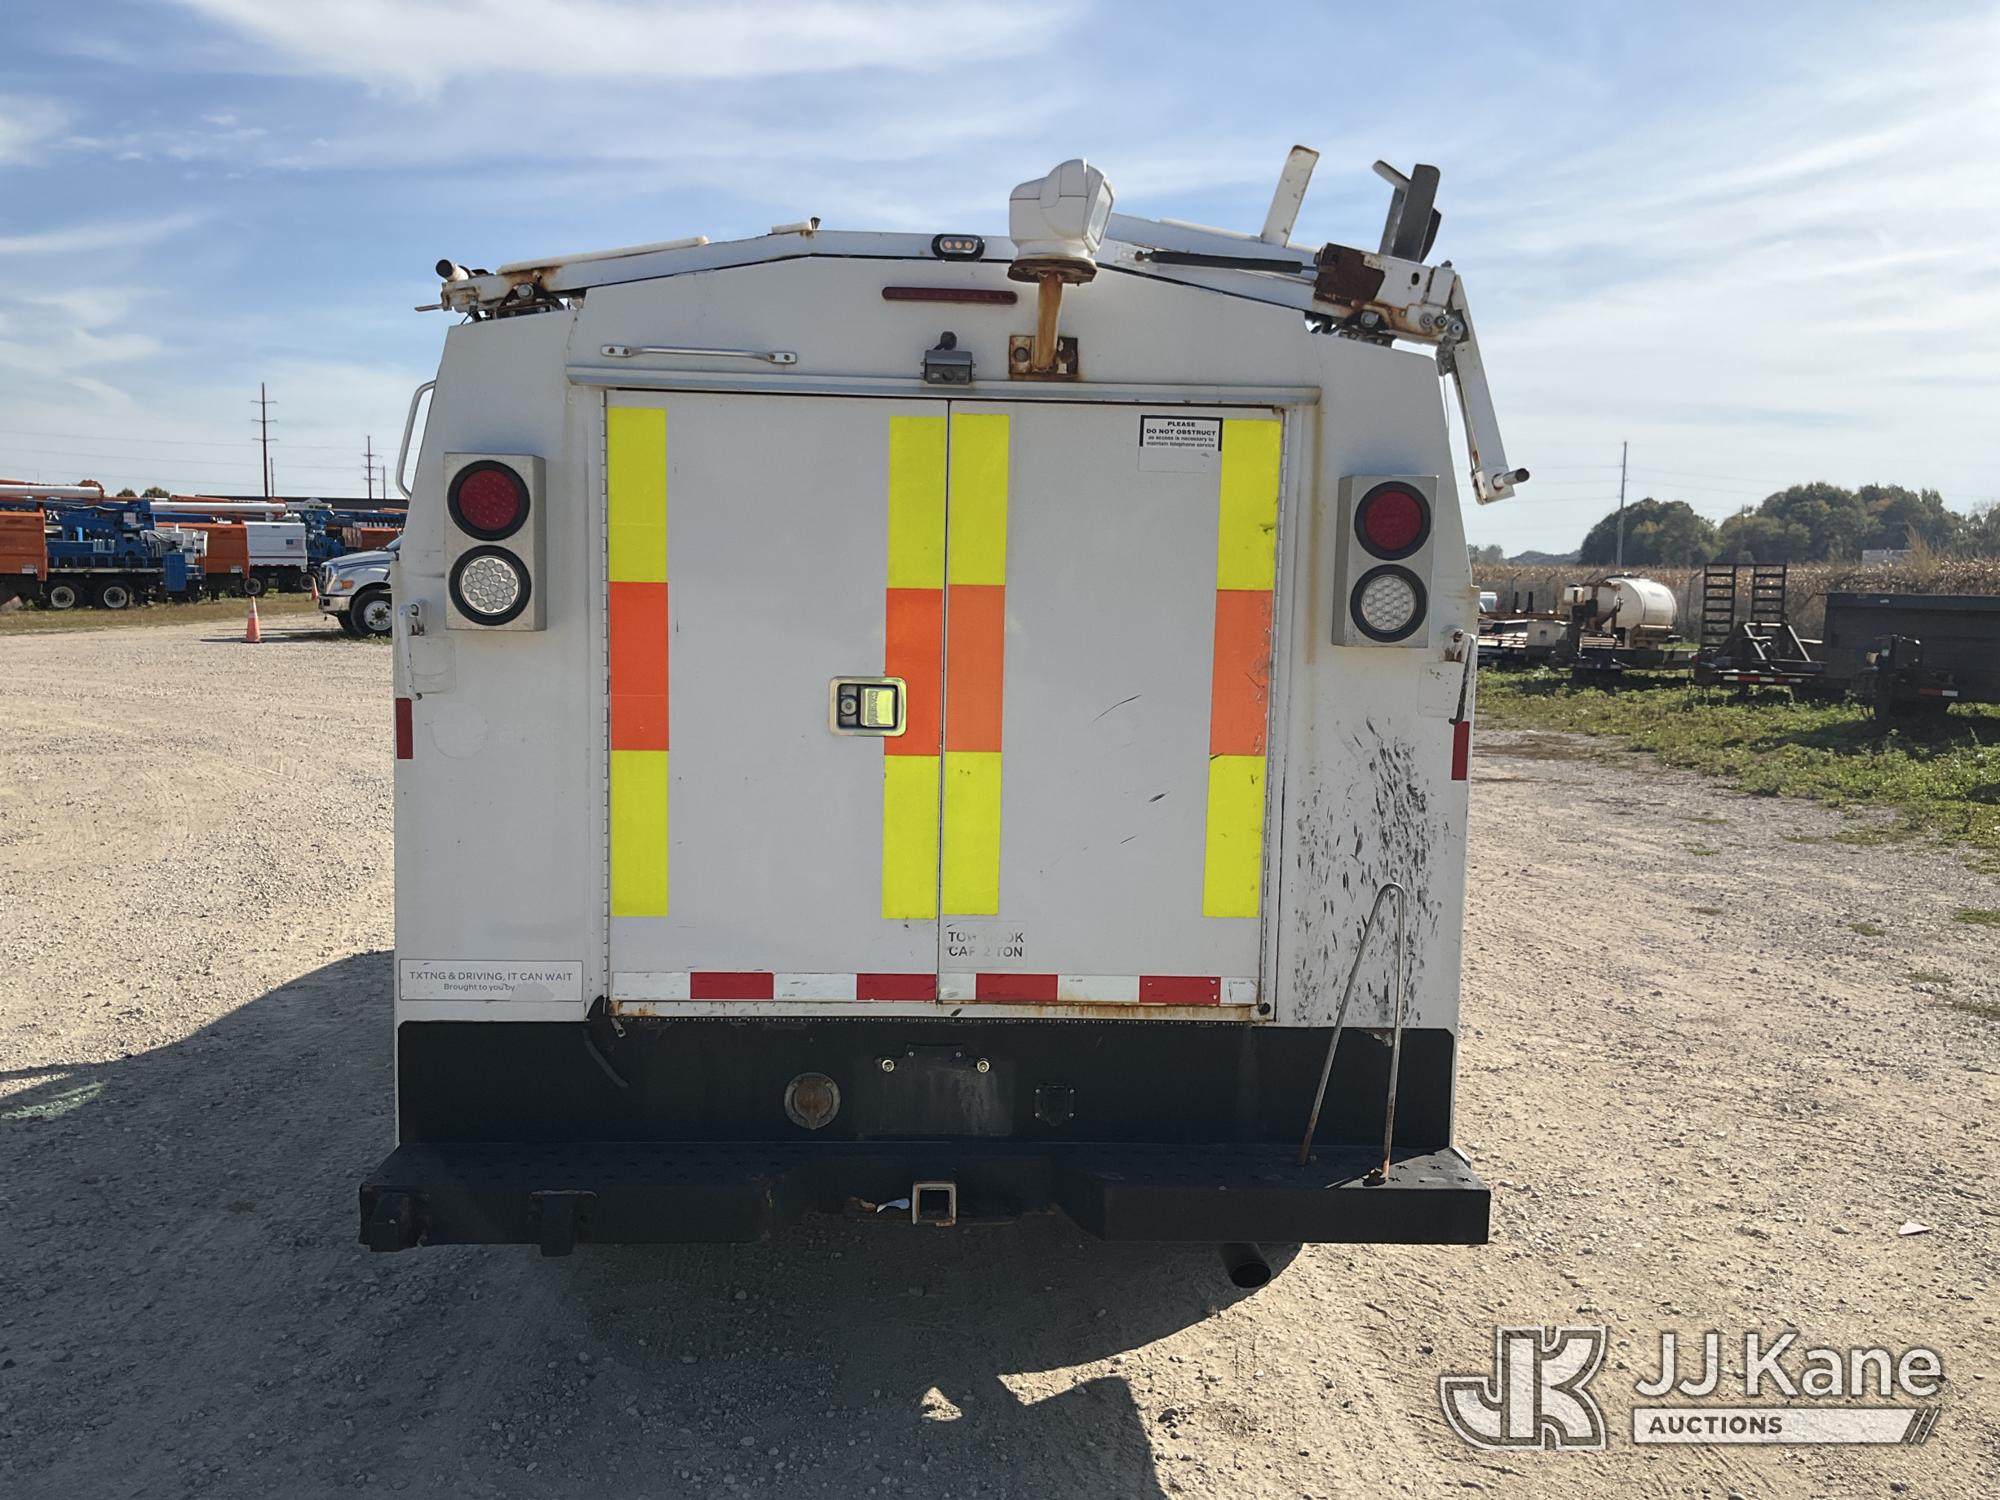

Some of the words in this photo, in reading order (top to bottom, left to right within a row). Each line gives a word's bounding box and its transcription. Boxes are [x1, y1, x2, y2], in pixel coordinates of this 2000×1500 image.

[409, 971, 446, 980] TXTNG
[448, 971, 457, 980] &
[458, 972, 506, 982] DRIVING,
[507, 972, 518, 981] IT
[519, 972, 543, 981] CAN
[545, 972, 573, 981] WAIT
[443, 983, 478, 992] Brought
[505, 983, 516, 992] by
